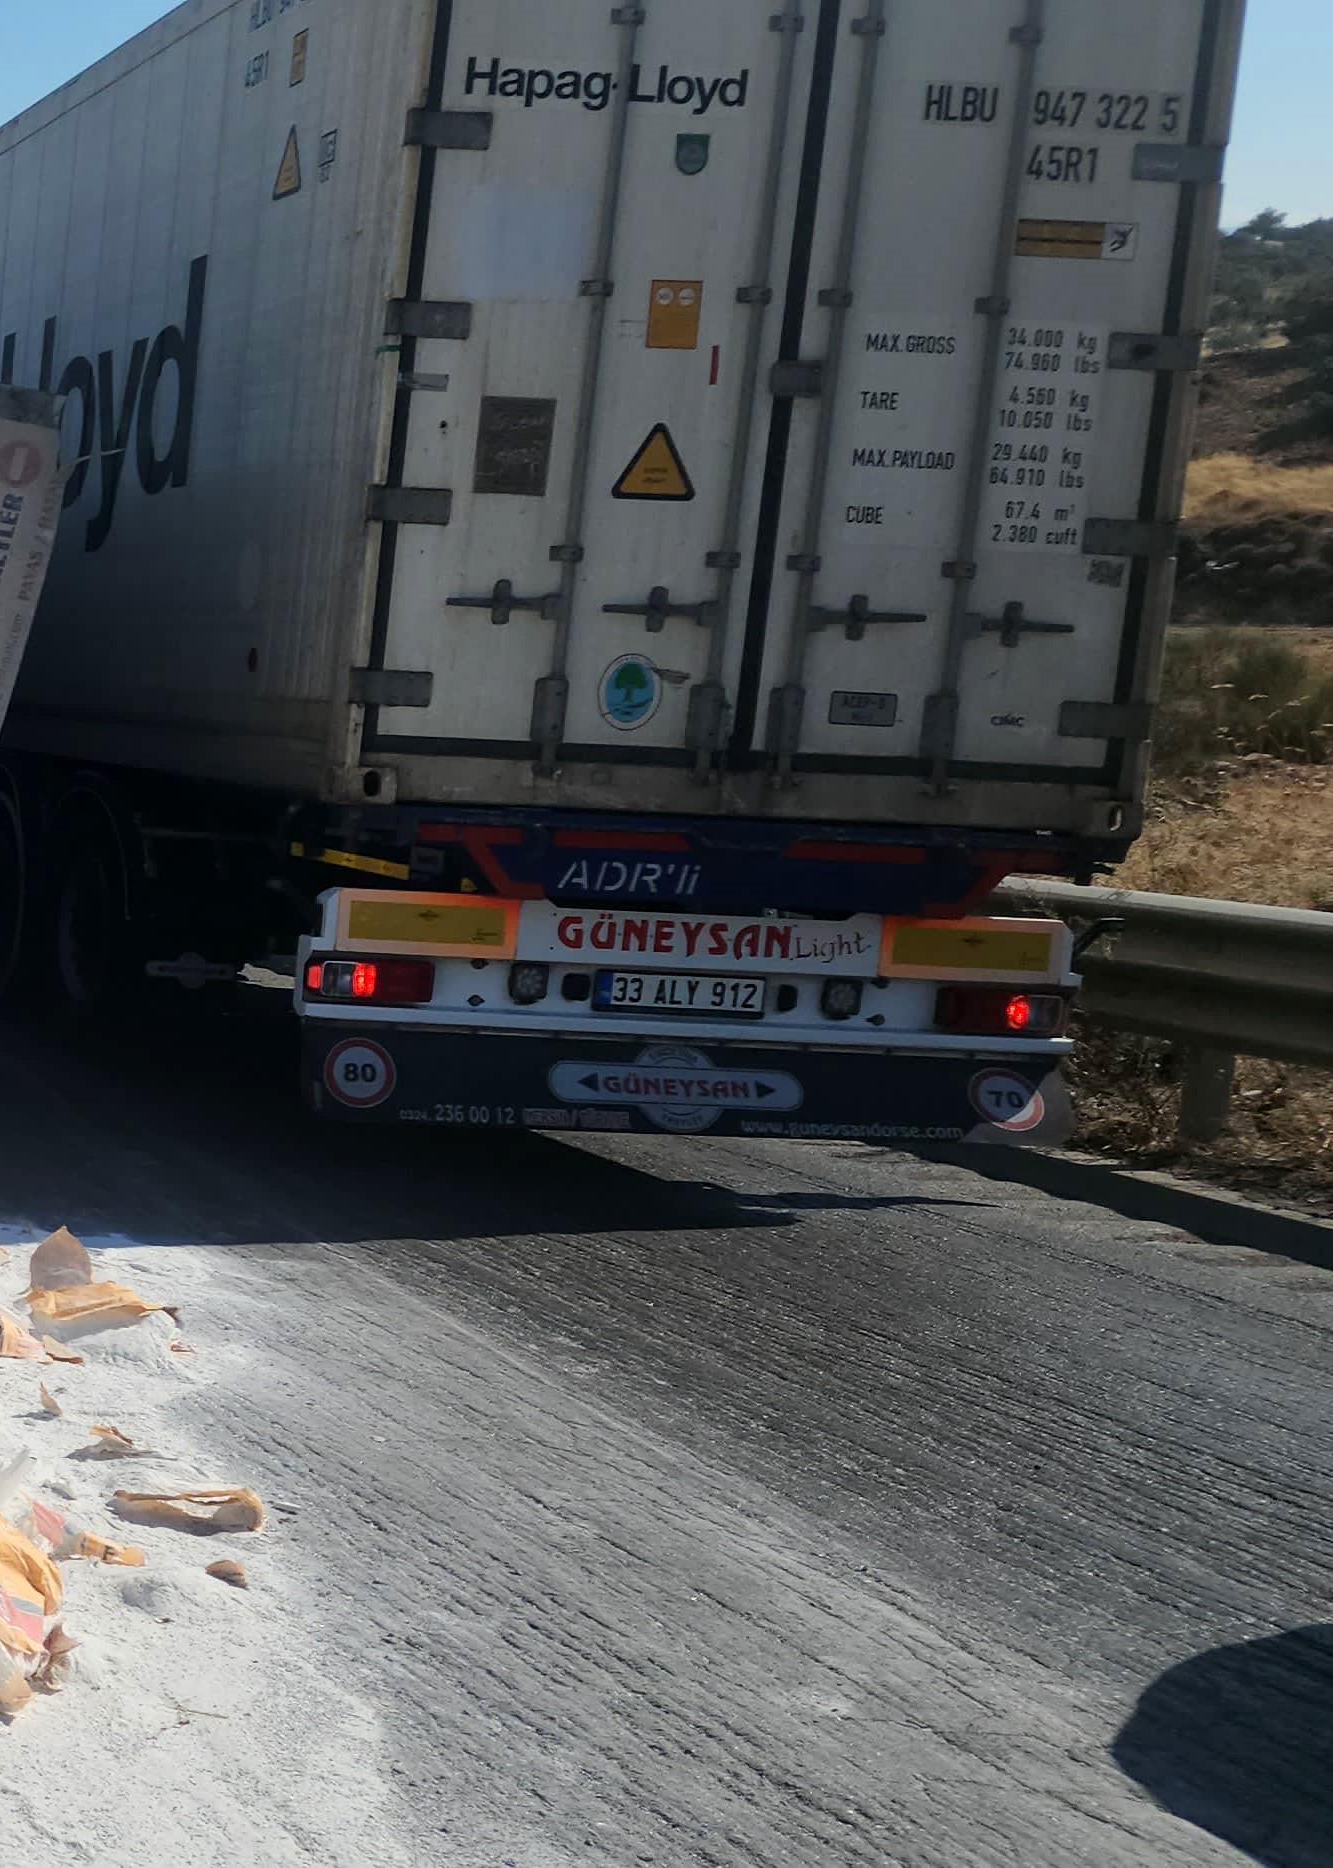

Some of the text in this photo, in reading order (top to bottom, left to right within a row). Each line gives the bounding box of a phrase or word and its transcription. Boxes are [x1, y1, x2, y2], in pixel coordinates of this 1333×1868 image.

[924, 84, 1182, 133] HLBU 947 322 5
[1026, 145, 1100, 183] 45R1
[1007, 327, 1064, 348] 34.000
[1077, 331, 1097, 354] kg
[1004, 351, 1101, 374] 74.960 lbs
[860, 391, 900, 411] TARE
[1069, 389, 1090, 412] kg
[999, 409, 1093, 432] 10.050 lbs
[991, 443, 1048, 464] 29.440
[1061, 447, 1082, 470] kg
[989, 467, 1084, 489] 64.910 lbs
[845, 505, 884, 525] CUBE
[1004, 501, 1040, 521] 67.4
[991, 524, 1077, 546] 2.380 cuft
[557, 860, 702, 897] ADR'li
[557, 913, 871, 963] GÜNEYSAN Light
[612, 976, 759, 1010] 33 ALY 912
[343, 1063, 377, 1083] 80
[602, 1070, 750, 1100] GÜNEYSAN
[987, 1089, 1023, 1109] 70
[435, 1104, 464, 1124] 236
[468, 1106, 491, 1125] 00
[495, 1107, 516, 1126] 12
